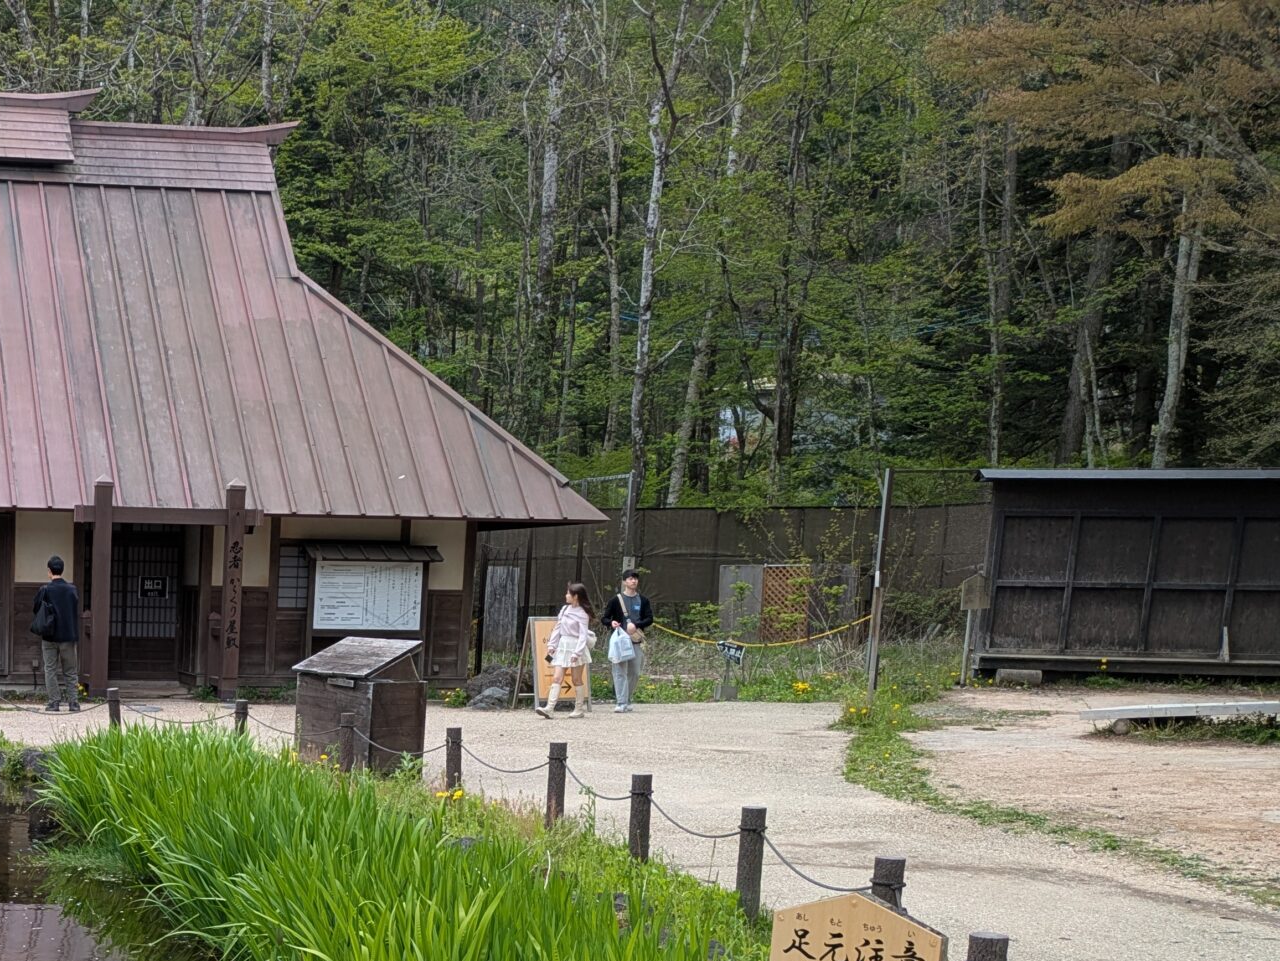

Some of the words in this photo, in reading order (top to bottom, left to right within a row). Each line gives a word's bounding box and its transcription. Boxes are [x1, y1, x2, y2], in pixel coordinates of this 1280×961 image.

[144, 579, 161, 589] 出口
[796, 912, 808, 921] あし
[830, 918, 842, 927] もと
[862, 923, 882, 932] ちゅう
